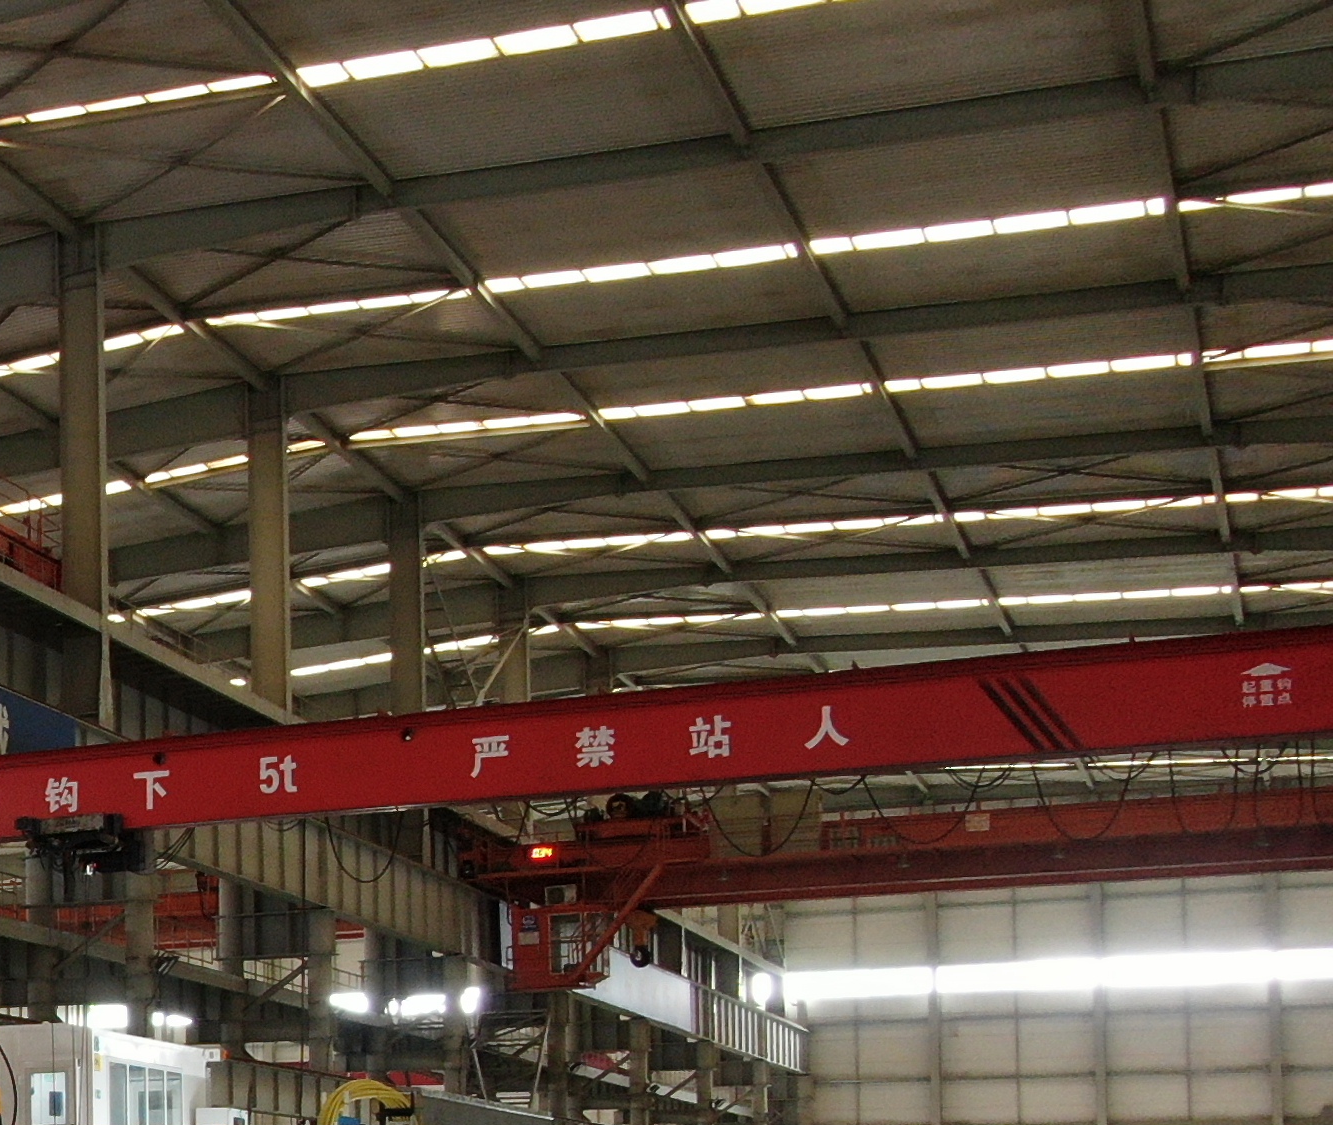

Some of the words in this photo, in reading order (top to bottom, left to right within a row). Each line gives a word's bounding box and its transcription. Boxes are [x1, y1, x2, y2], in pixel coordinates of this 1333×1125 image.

[259, 755, 298, 796] 5t
[471, 705, 850, 778] 严禁站人
